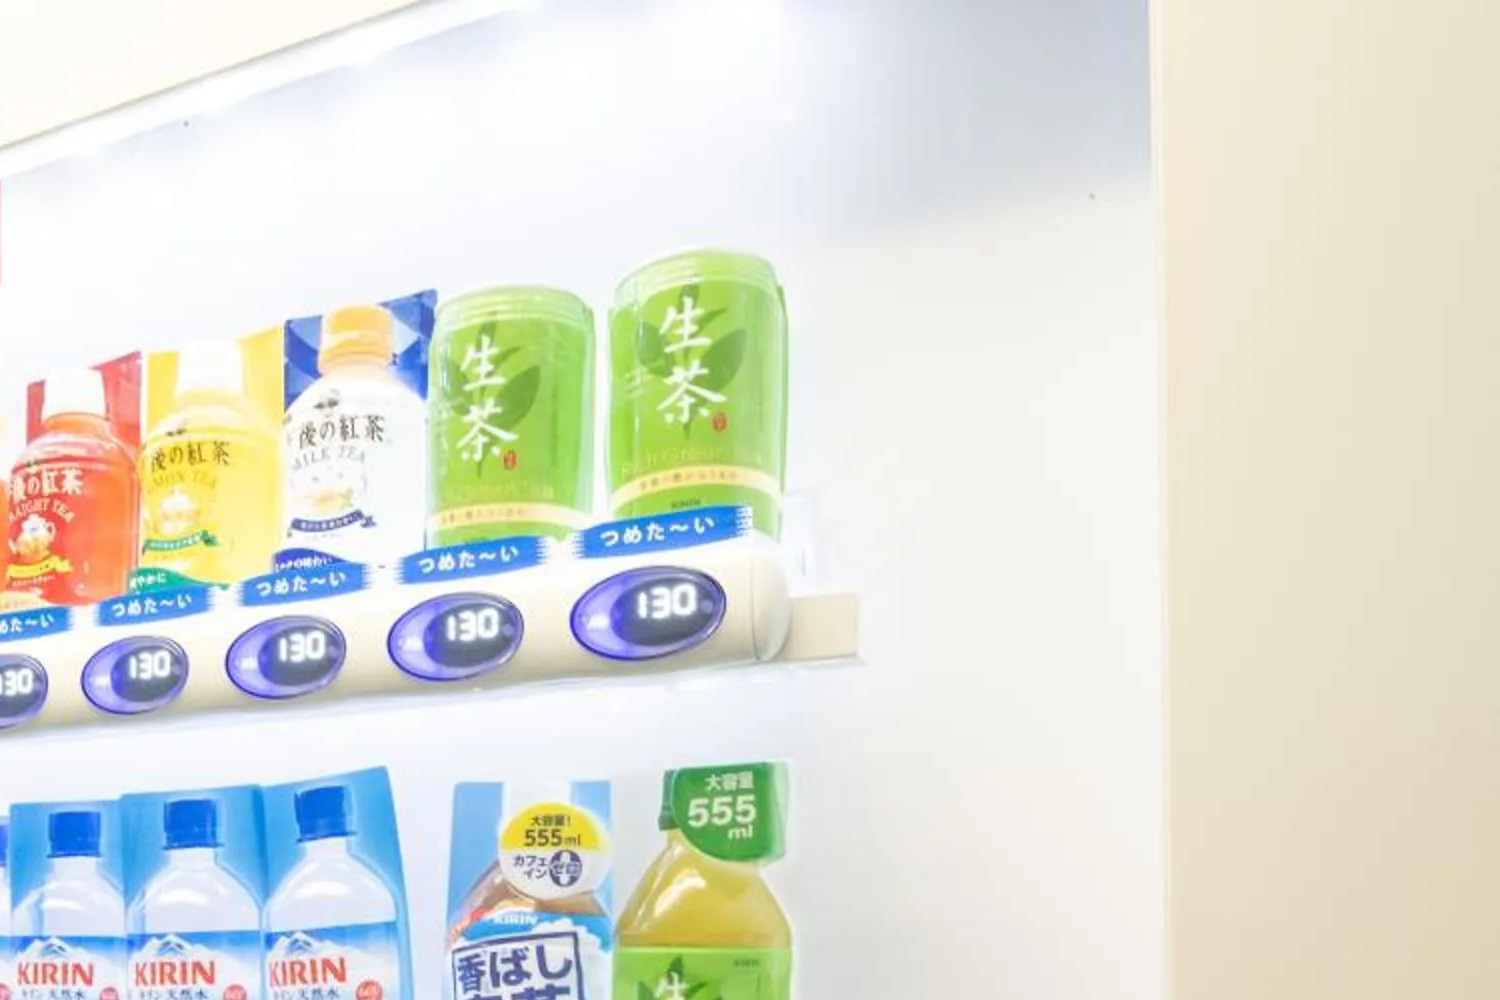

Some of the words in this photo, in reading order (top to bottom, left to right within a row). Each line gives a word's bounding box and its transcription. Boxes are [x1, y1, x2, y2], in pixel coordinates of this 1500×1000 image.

[655, 295, 729, 426] 生茶
[454, 334, 519, 464] 生茶
[636, 583, 697, 620] 130
[446, 608, 499, 642] 130
[277, 631, 326, 663] 130
[128, 650, 171, 679] 130
[705, 771, 755, 792] 大容量
[688, 795, 757, 829] 555
[728, 826, 753, 840] ml
[17, 961, 94, 987] KIRIN
[135, 960, 216, 987] KIRIN
[269, 957, 347, 987] KIRIN
[457, 945, 573, 995] 香ばし
